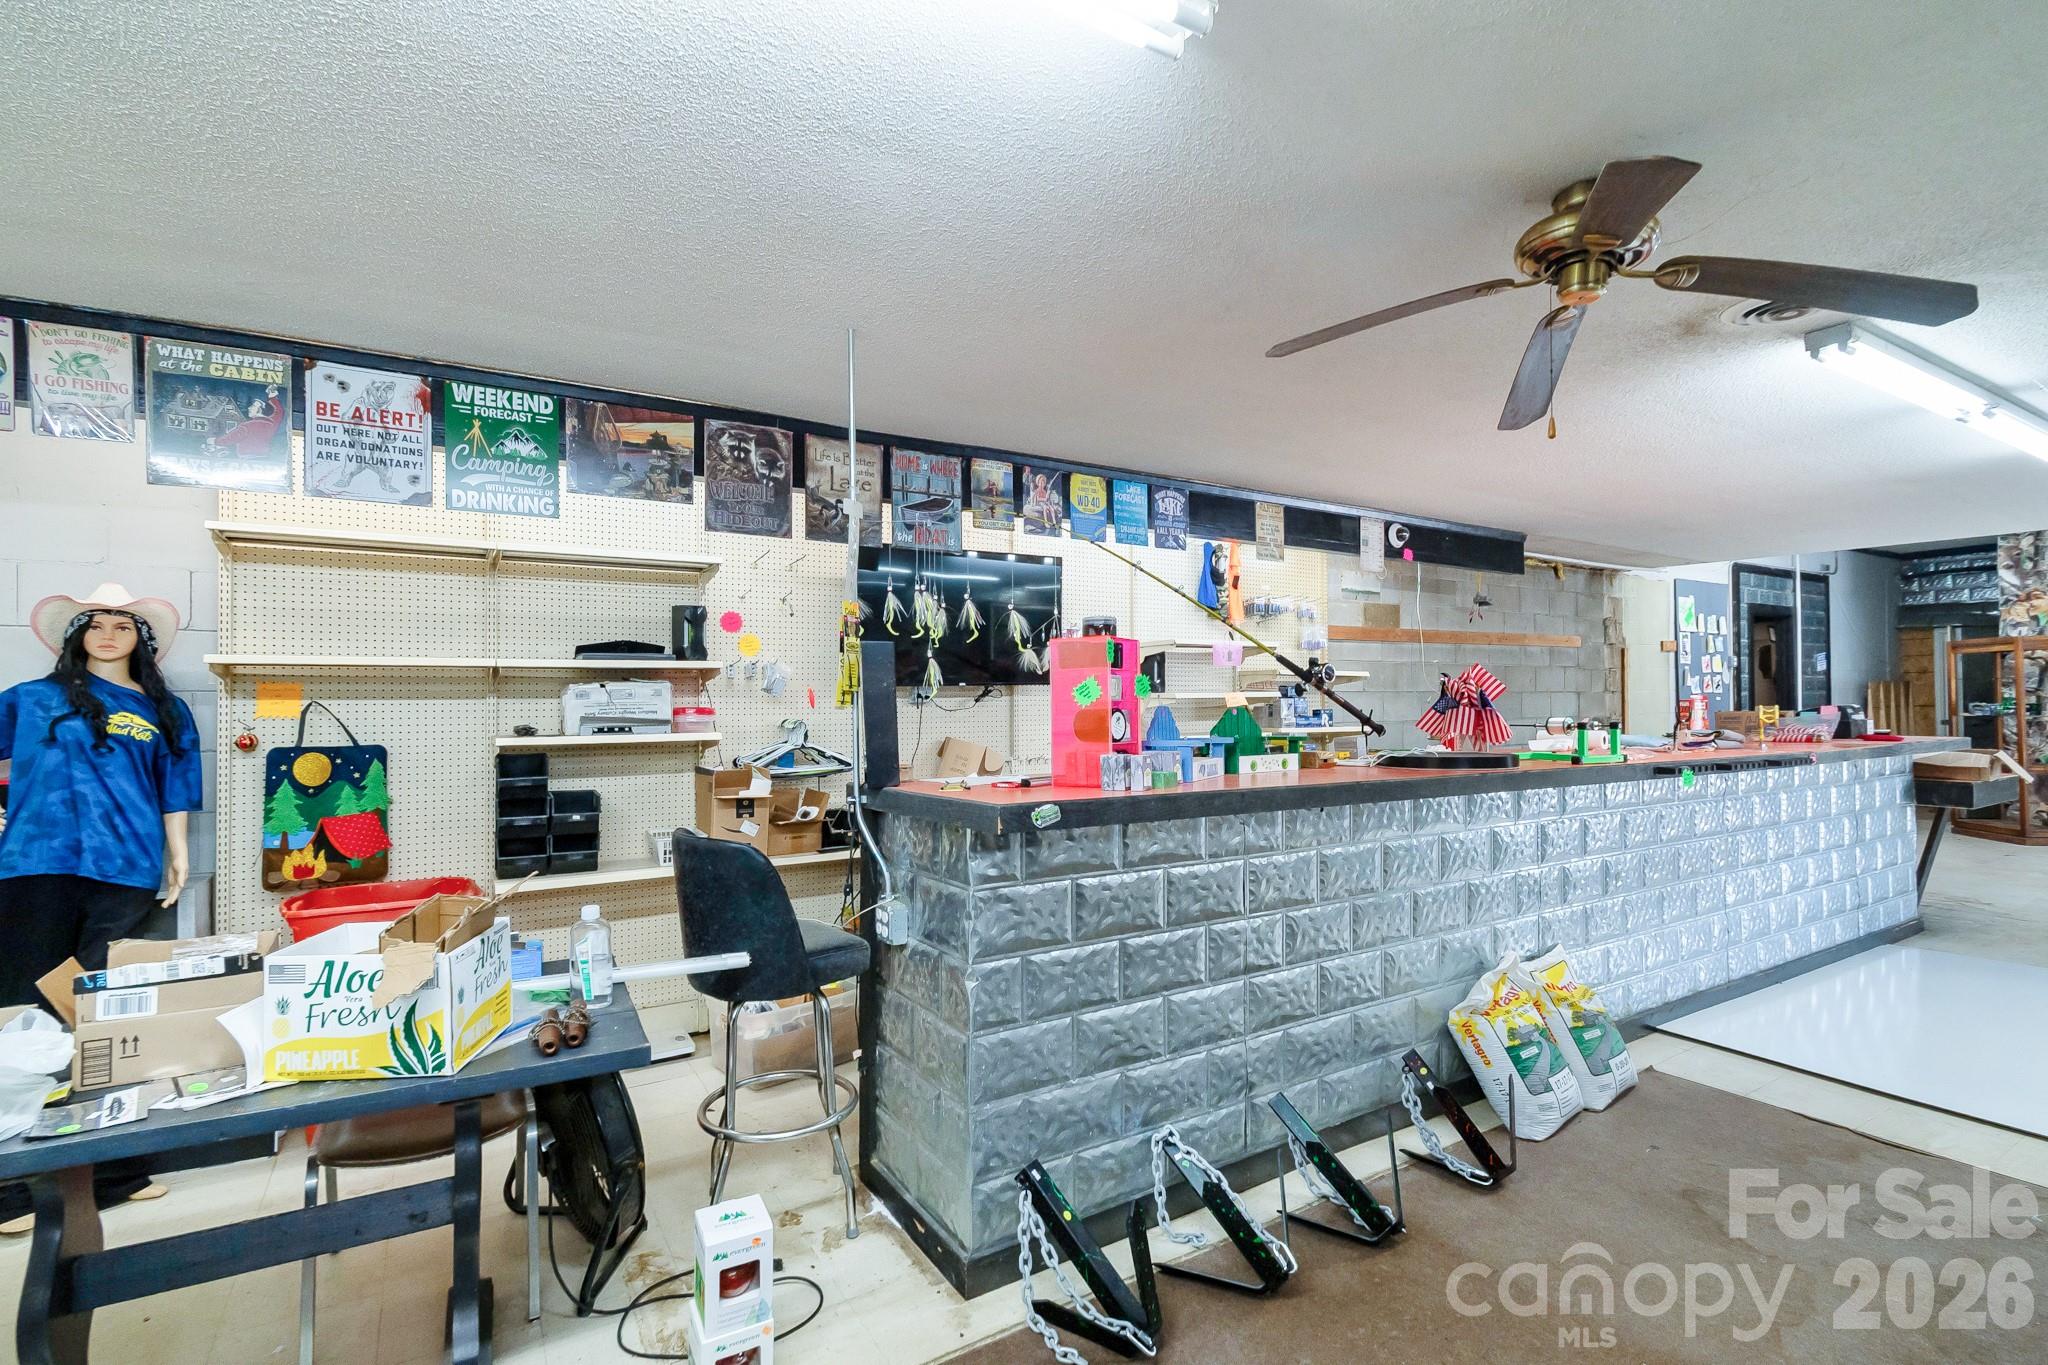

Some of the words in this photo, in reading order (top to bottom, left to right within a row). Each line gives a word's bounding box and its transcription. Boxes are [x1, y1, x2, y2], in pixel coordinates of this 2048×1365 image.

[40, 328, 69, 337] DON'T
[74, 329, 88, 339] GO
[92, 333, 129, 349] FISHING
[156, 343, 205, 361] WHAT
[211, 351, 284, 372] HAPPENS
[159, 359, 175, 369] at
[180, 358, 203, 372] the
[208, 363, 284, 384] CABIN
[45, 375, 66, 387] GO
[71, 377, 129, 394] FISHING
[451, 382, 554, 415] WEEKEND
[316, 400, 341, 418] BE
[351, 406, 424, 429] ALERT!
[474, 407, 533, 423] FORECAST
[316, 423, 339, 434] OUT
[377, 430, 399, 442] NOT
[401, 433, 423, 444] ALL
[316, 436, 356, 450] ORGAN
[360, 441, 424, 457] DONATIONS
[814, 447, 831, 461] Life
[316, 450, 341, 462] ARE
[346, 454, 424, 471] VOLUNTARY!
[451, 444, 555, 487] Camping
[895, 454, 921, 472] HOME
[929, 460, 959, 478] WHERE
[485, 484, 505, 492] WITH
[513, 486, 543, 497] CHANCE
[545, 489, 555, 497] OF
[830, 465, 872, 492] Lae
[451, 489, 555, 516] DRINKING
[1158, 497, 1184, 516] LAKE
[897, 531, 913, 543] the
[474, 933, 503, 975] Aloe
[304, 960, 385, 999] Aloe
[474, 956, 508, 1003] Fresh
[1461, 1020, 1491, 1066] Vertagro
[274, 1049, 361, 1071] PINEAPPLE
